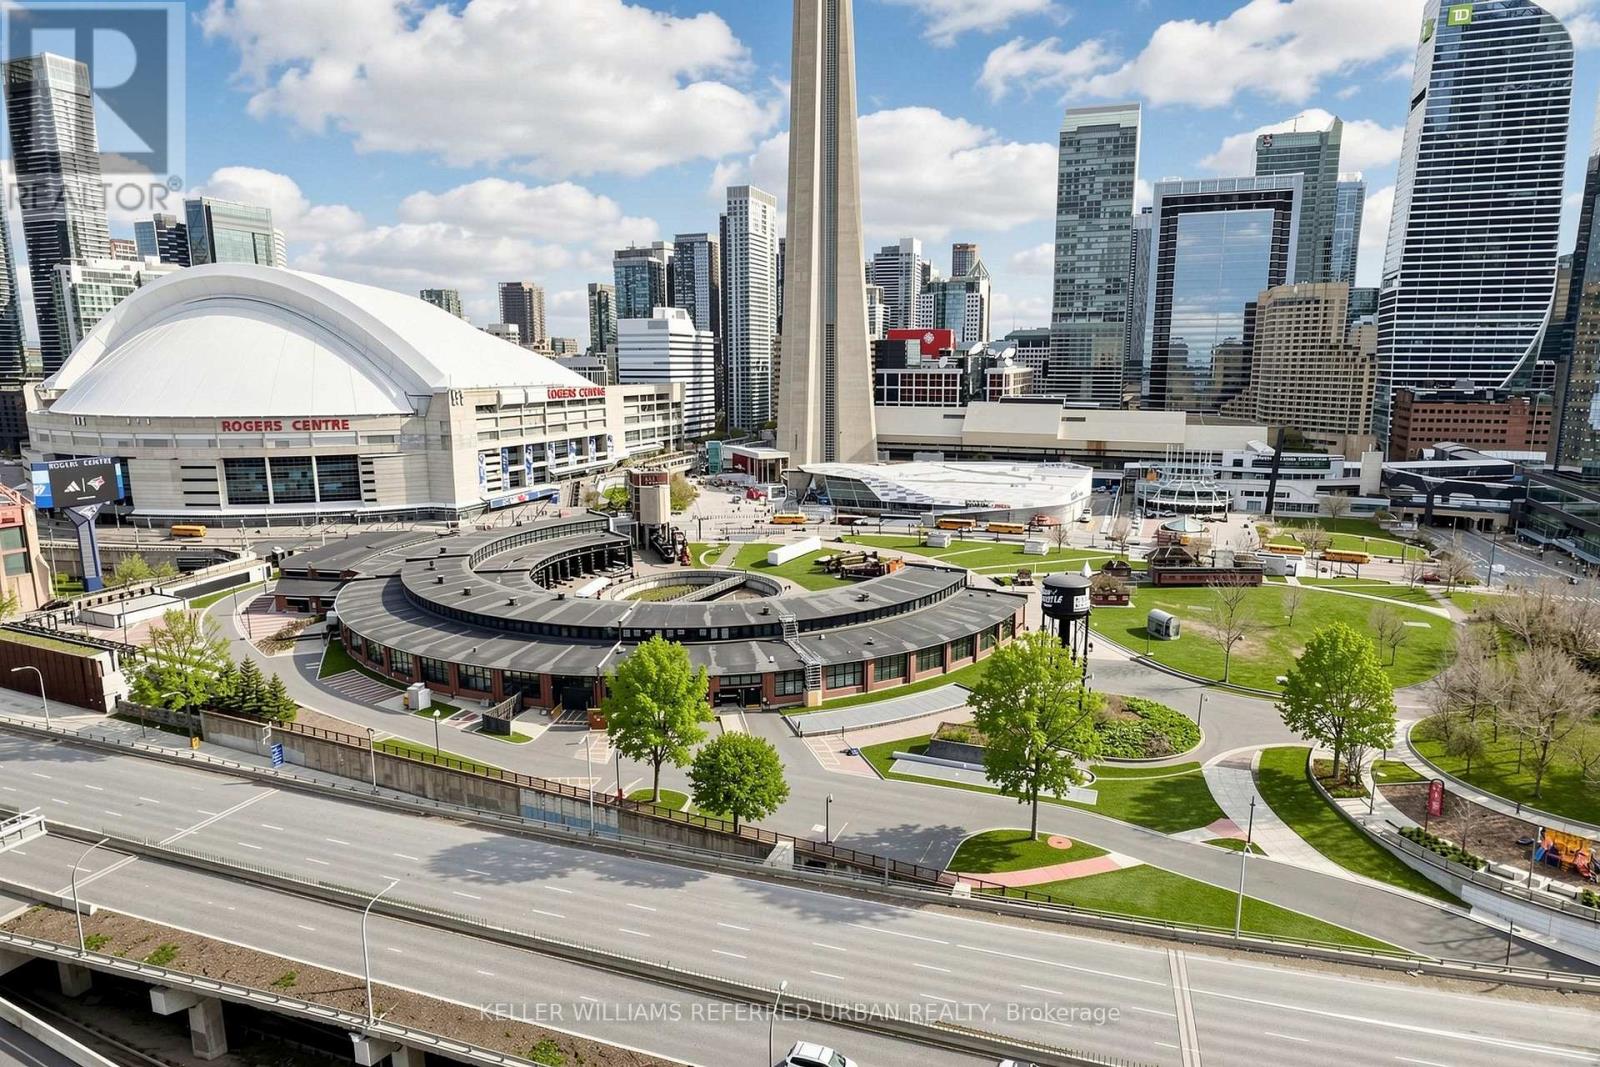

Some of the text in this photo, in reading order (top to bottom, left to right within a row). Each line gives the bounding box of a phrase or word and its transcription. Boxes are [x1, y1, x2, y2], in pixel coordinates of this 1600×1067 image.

[1452, 8, 1470, 22] TD
[221, 419, 350, 432] ROGERS CENTRE
